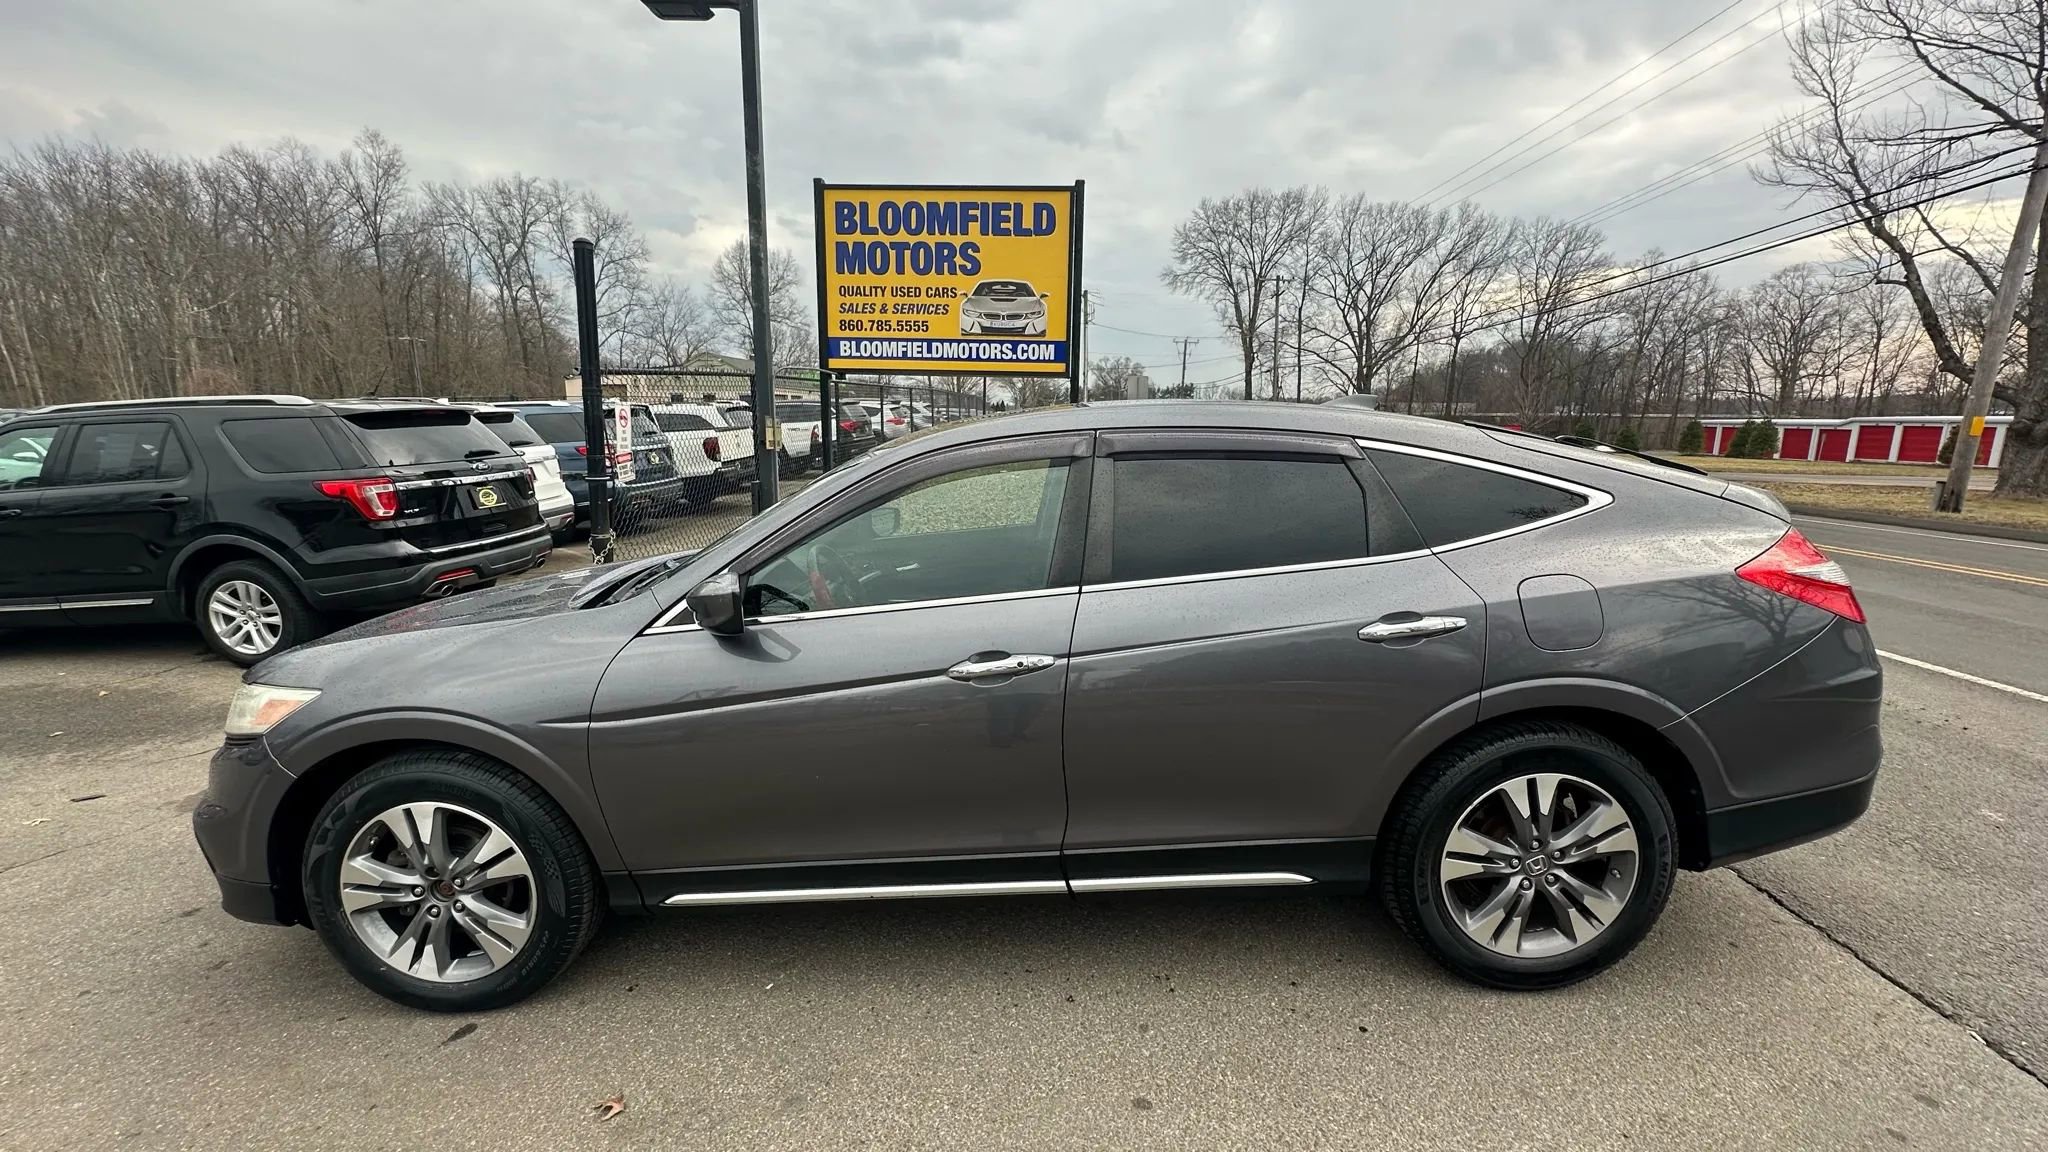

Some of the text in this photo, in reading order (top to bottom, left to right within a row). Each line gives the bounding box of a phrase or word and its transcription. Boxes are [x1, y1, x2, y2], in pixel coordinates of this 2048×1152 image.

[835, 201, 1056, 237] BLOOMFIELD
[835, 241, 981, 276] MOTORS
[839, 285, 958, 299] QUALITY USED CARS
[839, 303, 950, 315] SALES & SERVICES
[839, 319, 929, 333] 860.785.5555
[839, 340, 1055, 360] BLOOMFIELDMOTORS.COM
